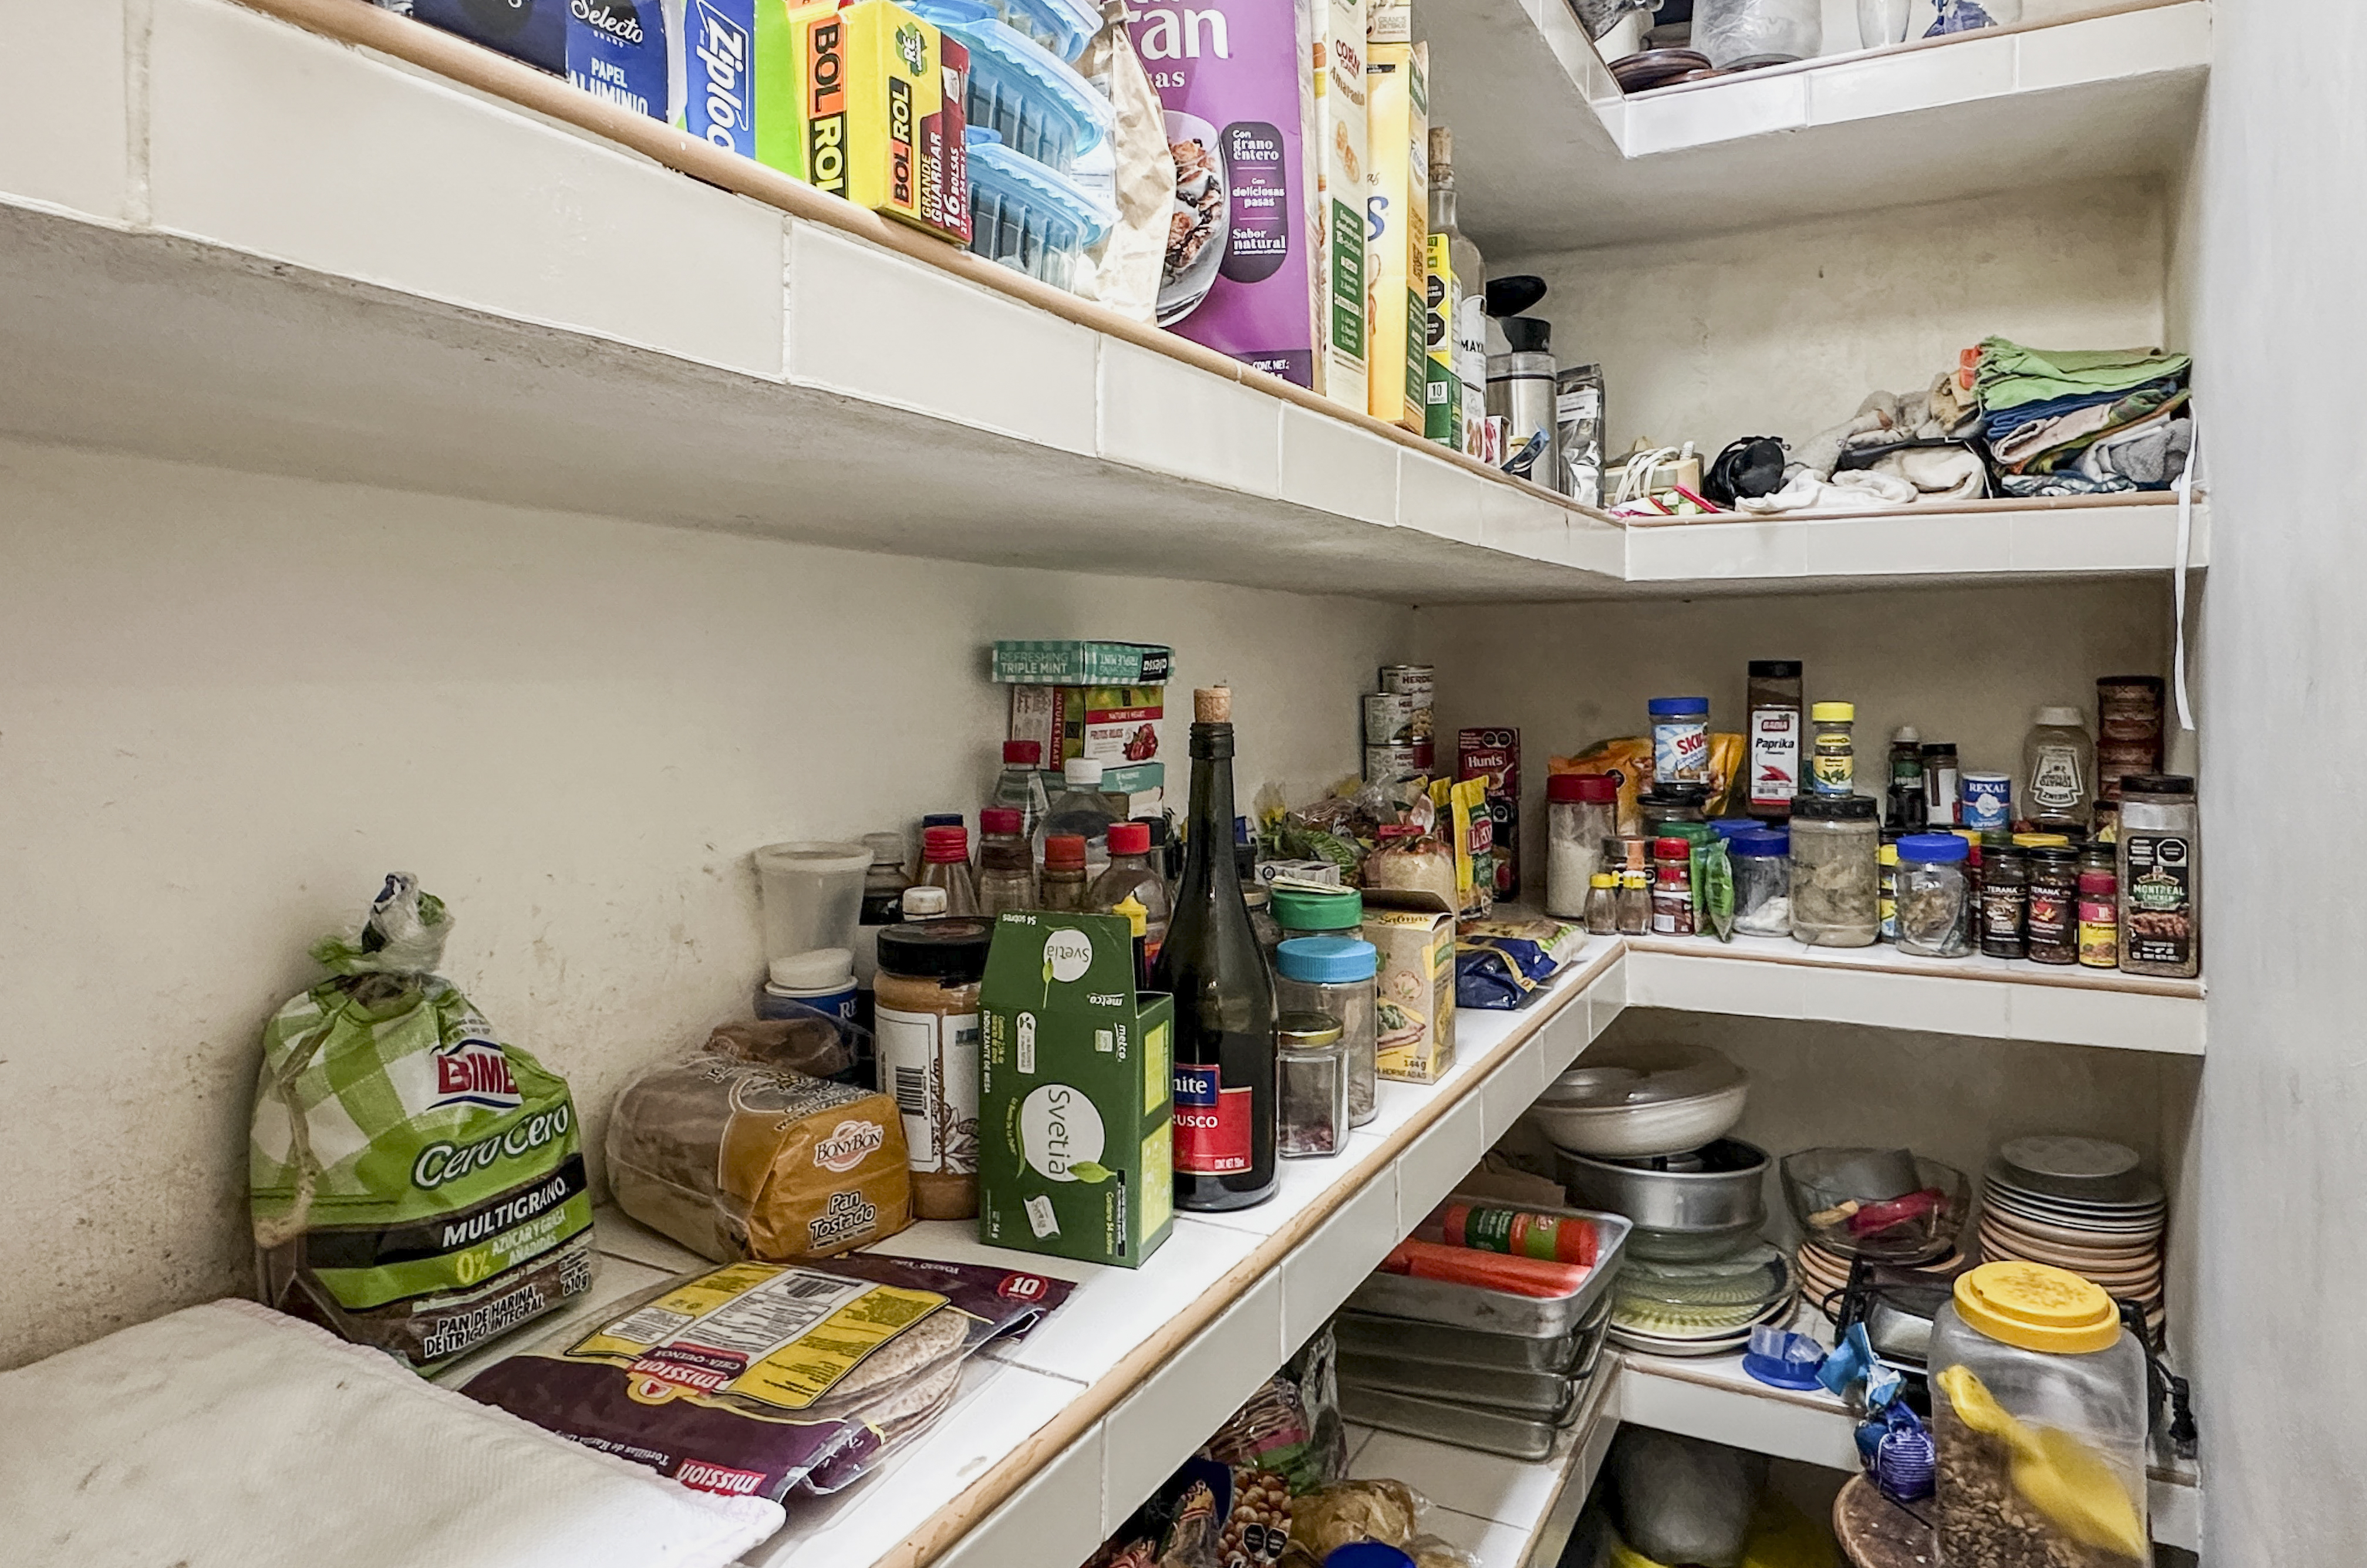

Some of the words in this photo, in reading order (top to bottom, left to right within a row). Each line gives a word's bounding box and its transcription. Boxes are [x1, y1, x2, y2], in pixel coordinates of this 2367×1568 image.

[571, 0, 643, 45] Selecto
[591, 57, 628, 89] PAPEL
[815, 22, 841, 113] BOL
[1148, 70, 1185, 89] as
[892, 83, 909, 143] ROL
[1232, 129, 1252, 139] Con
[1233, 138, 1274, 154] grano
[1233, 149, 1280, 161] entero
[893, 147, 909, 203] BOL
[930, 131, 943, 223] GUARDAR
[949, 147, 960, 196] BOLSAS
[921, 153, 932, 218] GRANDE
[1232, 186, 1286, 198] deliciosas
[942, 194, 961, 228] 16
[1243, 197, 1276, 210] pasas
[1233, 227, 1267, 240] Sabor
[1233, 235, 1287, 250] natural
[1431, 383, 1442, 397] 10
[1000, 652, 1070, 663] REFRESHING
[1000, 663, 1037, 674] TRIPLE
[1039, 663, 1068, 674] MINT
[1755, 737, 1795, 750] Paprika
[1968, 783, 2008, 793] REXAL
[1987, 885, 2018, 894] TERANA
[2133, 884, 2185, 896] MONTREAL
[1002, 913, 1027, 923] sobres
[1027, 915, 1037, 926] 54
[1378, 914, 1431, 925] Salmas
[1047, 945, 1091, 963] Svetia
[1048, 1088, 1071, 1175] Svetia
[415, 1136, 502, 1187] Cero
[504, 1104, 568, 1155] Cero
[829, 1190, 861, 1215] Pan
[1106, 1191, 1114, 1222] Contiene
[443, 1176, 567, 1248] MULTIGRANO
[809, 1202, 876, 1241] Tostado
[456, 1251, 491, 1284] 0%
[1009, 1277, 1040, 1295] 10
[424, 1336, 444, 1358] DE
[446, 1321, 488, 1352] TRIGO
[489, 1293, 545, 1334] INTEGRAL
[437, 1315, 470, 1334] PAN
[473, 1307, 489, 1323] DE
[611, 1443, 624, 1452] de
[624, 1445, 670, 1467] Tortillas
